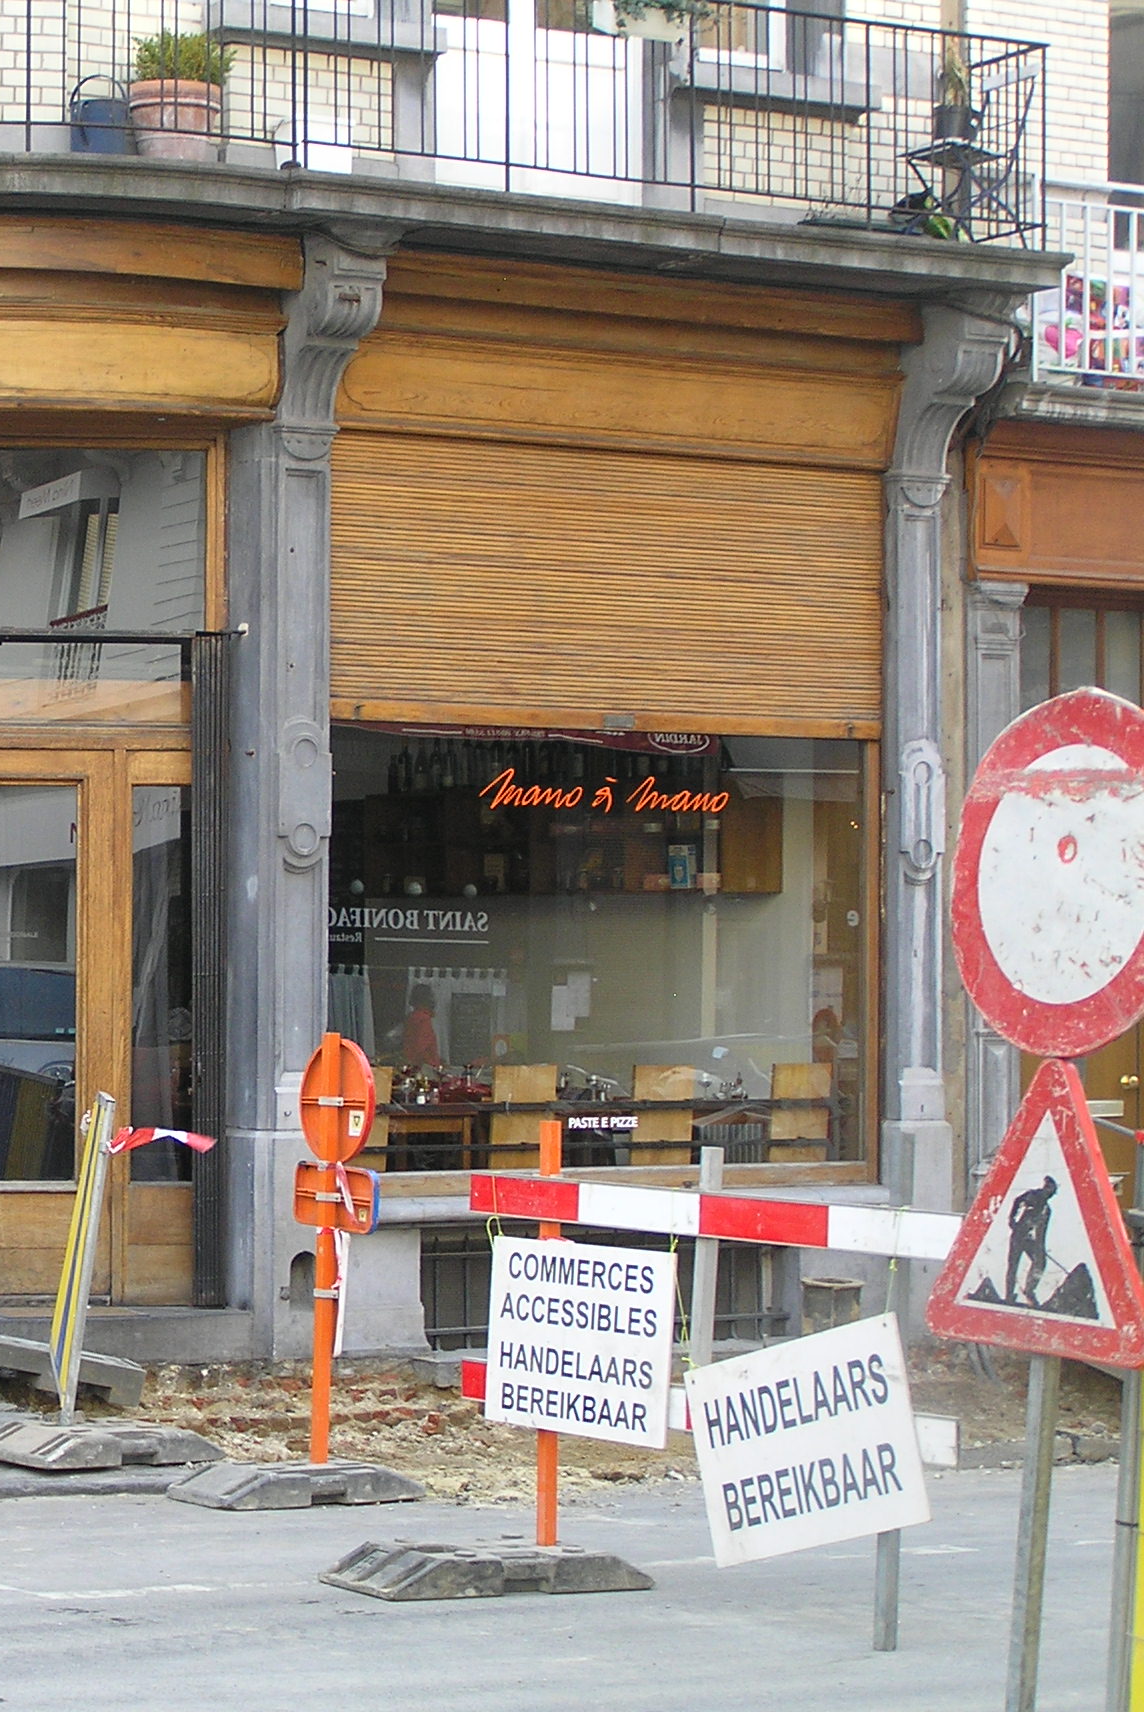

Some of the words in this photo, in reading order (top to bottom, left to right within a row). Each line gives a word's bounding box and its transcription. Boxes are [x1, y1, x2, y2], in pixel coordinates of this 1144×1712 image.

[568, 1116, 599, 1129] PASTE
[601, 1117, 609, 1128] E
[610, 1116, 639, 1128] PIZZE
[508, 1251, 655, 1295] COMMERCES
[500, 1292, 657, 1338] ACCESSIBLES
[499, 1340, 653, 1390] HANDELAARS
[501, 1382, 647, 1433] BEREIKBAAR
[703, 1352, 889, 1450] HANDELAARS
[722, 1442, 903, 1532] BEREIKBAAR
